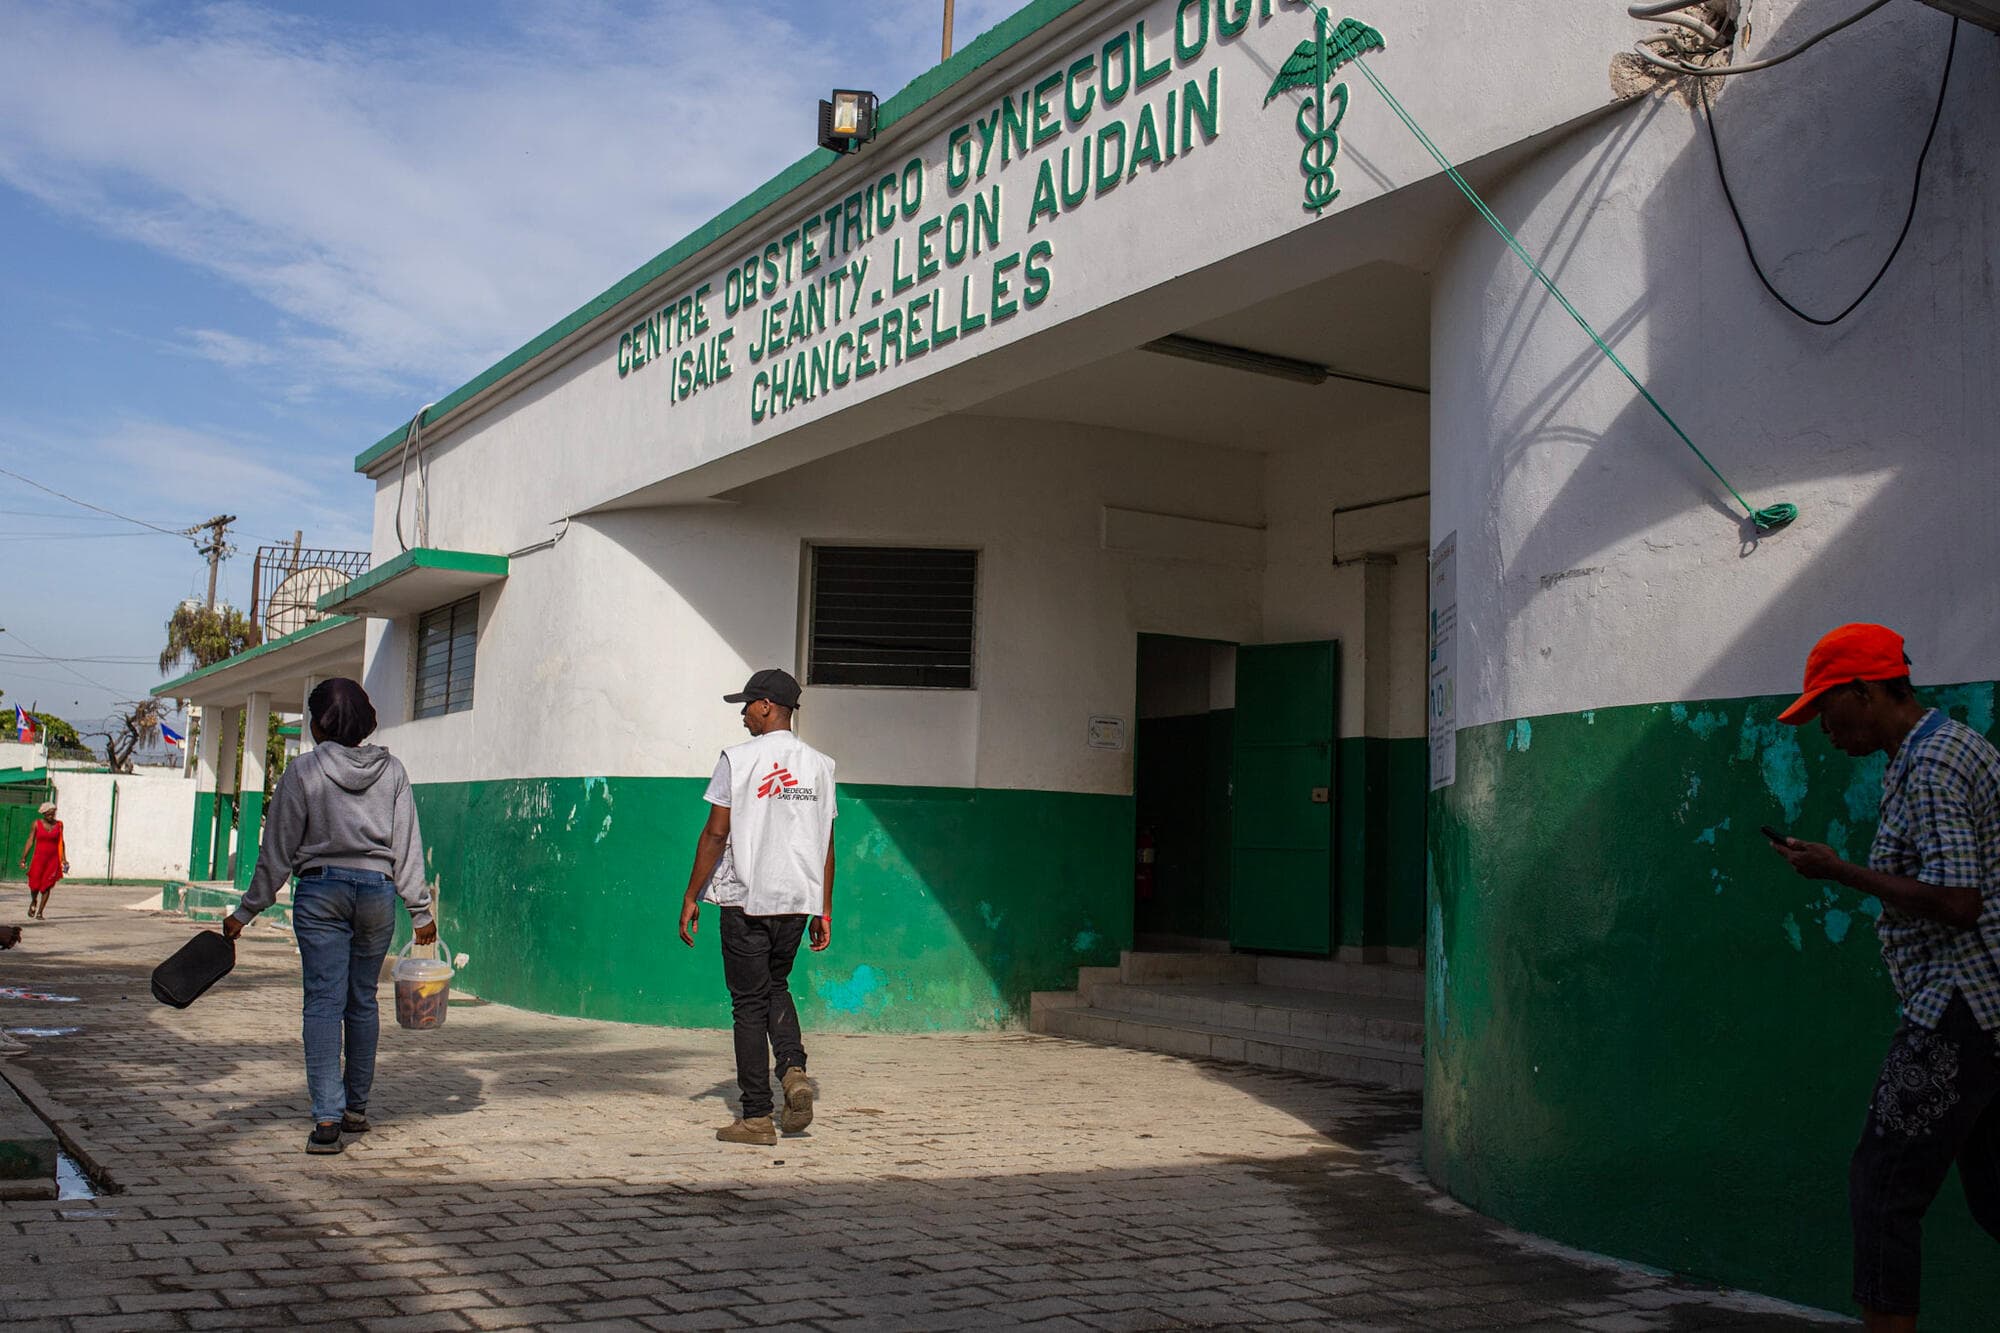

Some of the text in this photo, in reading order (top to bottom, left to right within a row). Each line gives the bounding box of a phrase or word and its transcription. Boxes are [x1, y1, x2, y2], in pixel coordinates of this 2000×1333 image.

[617, 0, 1276, 378] CENTRE OBSTETRICO GYNECOLOG
[670, 327, 735, 403] ISAIE
[892, 184, 1000, 295] LEON
[1028, 66, 1220, 230] AUDAIN
[751, 240, 1053, 422] CHANCERELLES
